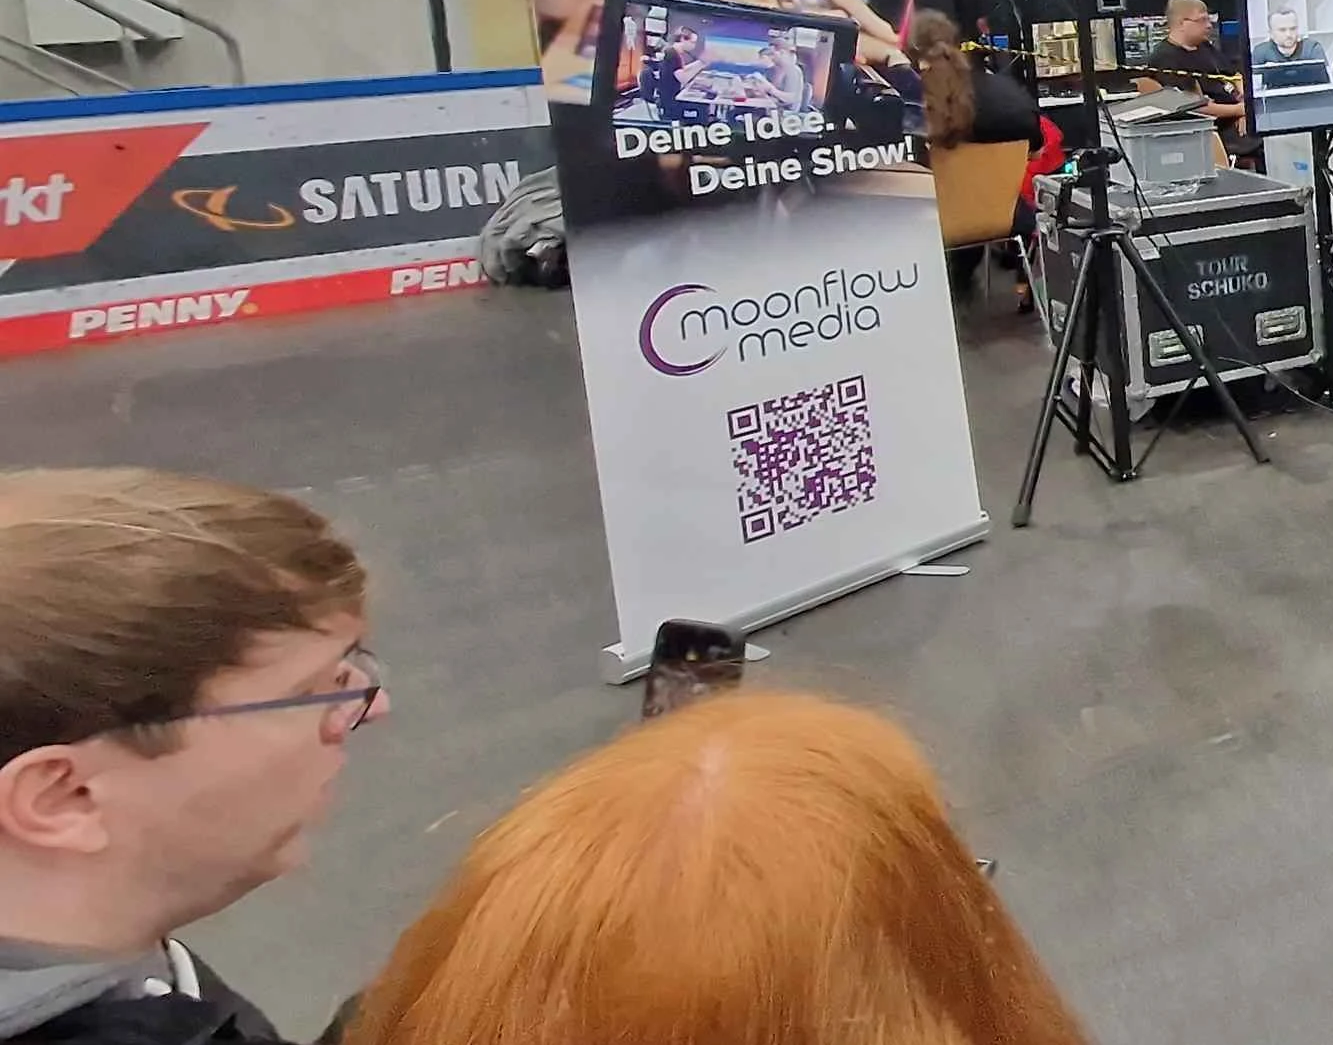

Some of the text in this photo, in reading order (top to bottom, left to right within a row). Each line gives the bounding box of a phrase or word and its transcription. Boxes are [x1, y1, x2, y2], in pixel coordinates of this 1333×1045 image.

[614, 111, 835, 160] Deine Idee.
[299, 159, 522, 225] SATURN
[689, 136, 915, 197] Deine Show!
[1187, 271, 1269, 301] SCHUKO
[1196, 255, 1249, 276] TOUR
[680, 262, 919, 341] moonflow
[739, 303, 883, 363] media
